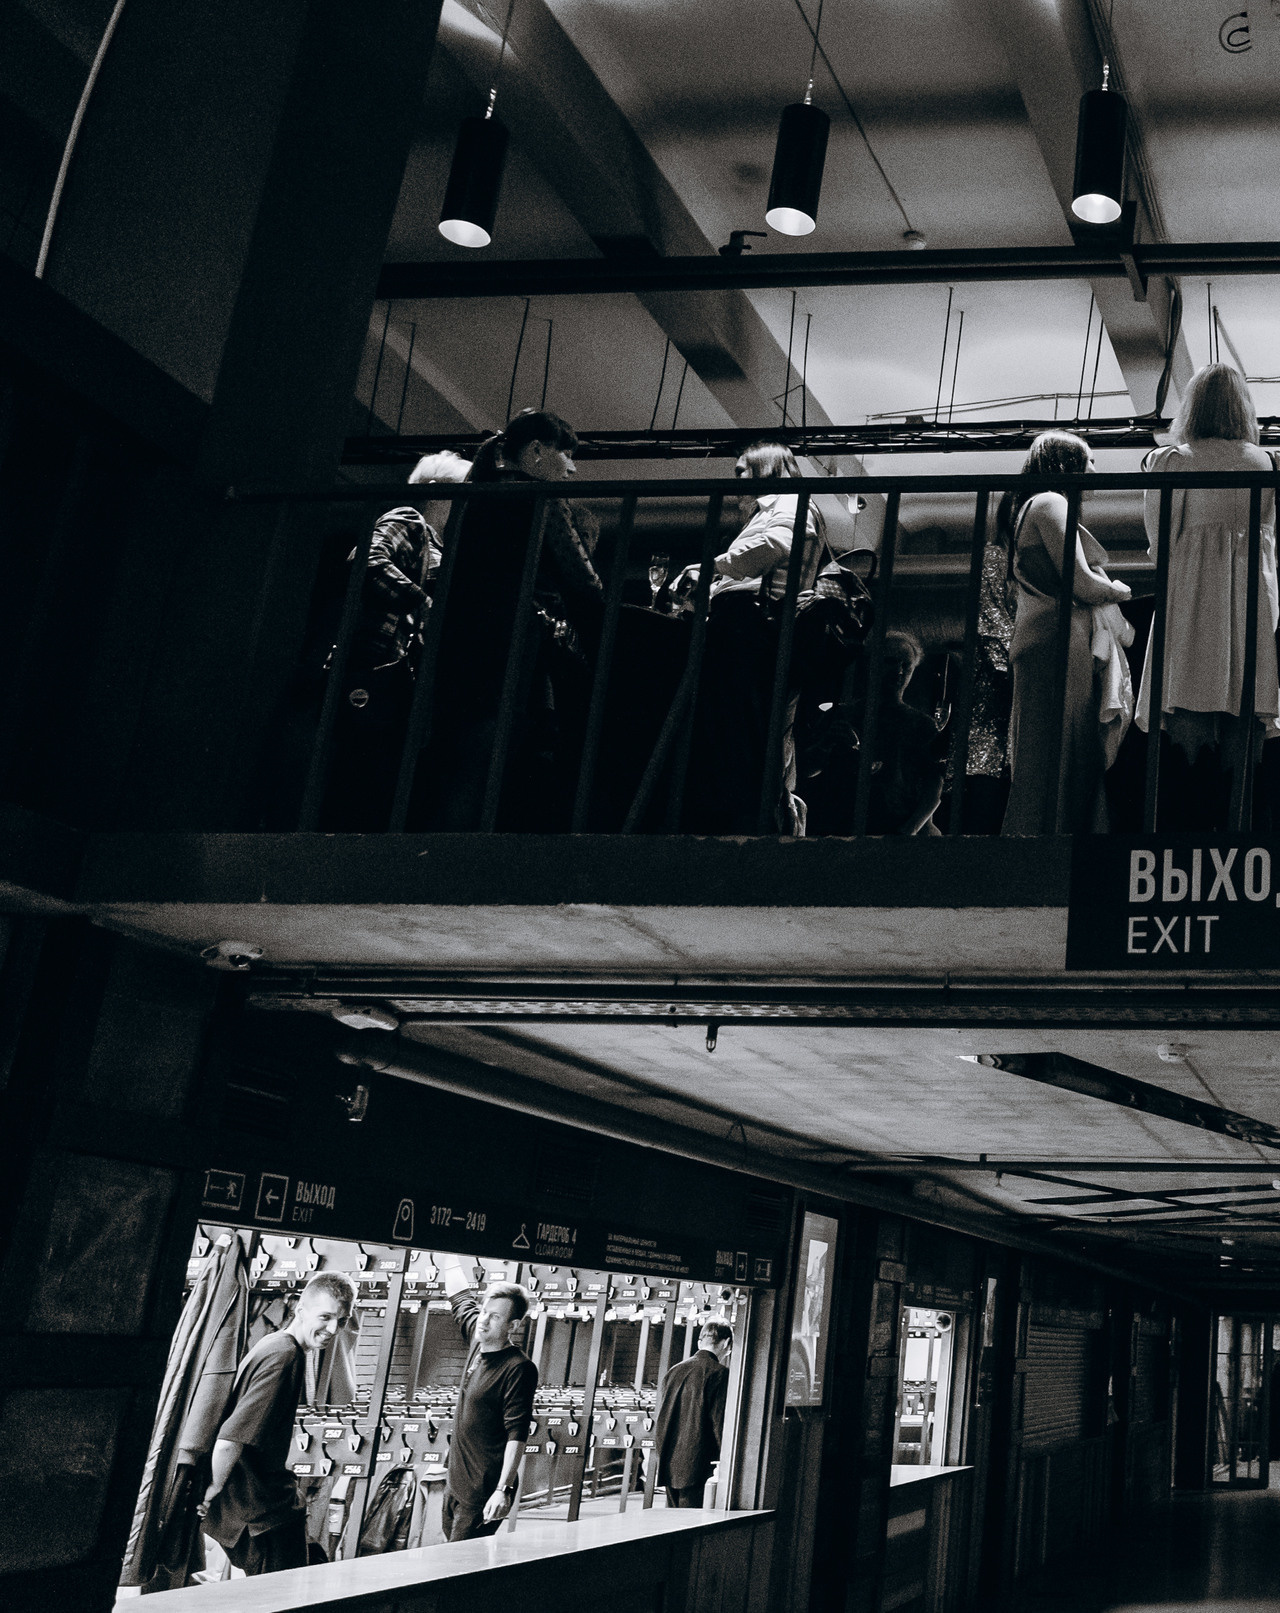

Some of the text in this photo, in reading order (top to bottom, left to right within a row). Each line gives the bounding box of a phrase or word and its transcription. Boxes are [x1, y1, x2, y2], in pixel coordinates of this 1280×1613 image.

[1126, 915, 1220, 954] EXIT
[295, 1180, 336, 1210] ВЫХОД
[292, 1206, 314, 1223] EXIT
[536, 1222, 577, 1244] ГАРДЕРОБ 4
[324, 1429, 343, 1438] 2567
